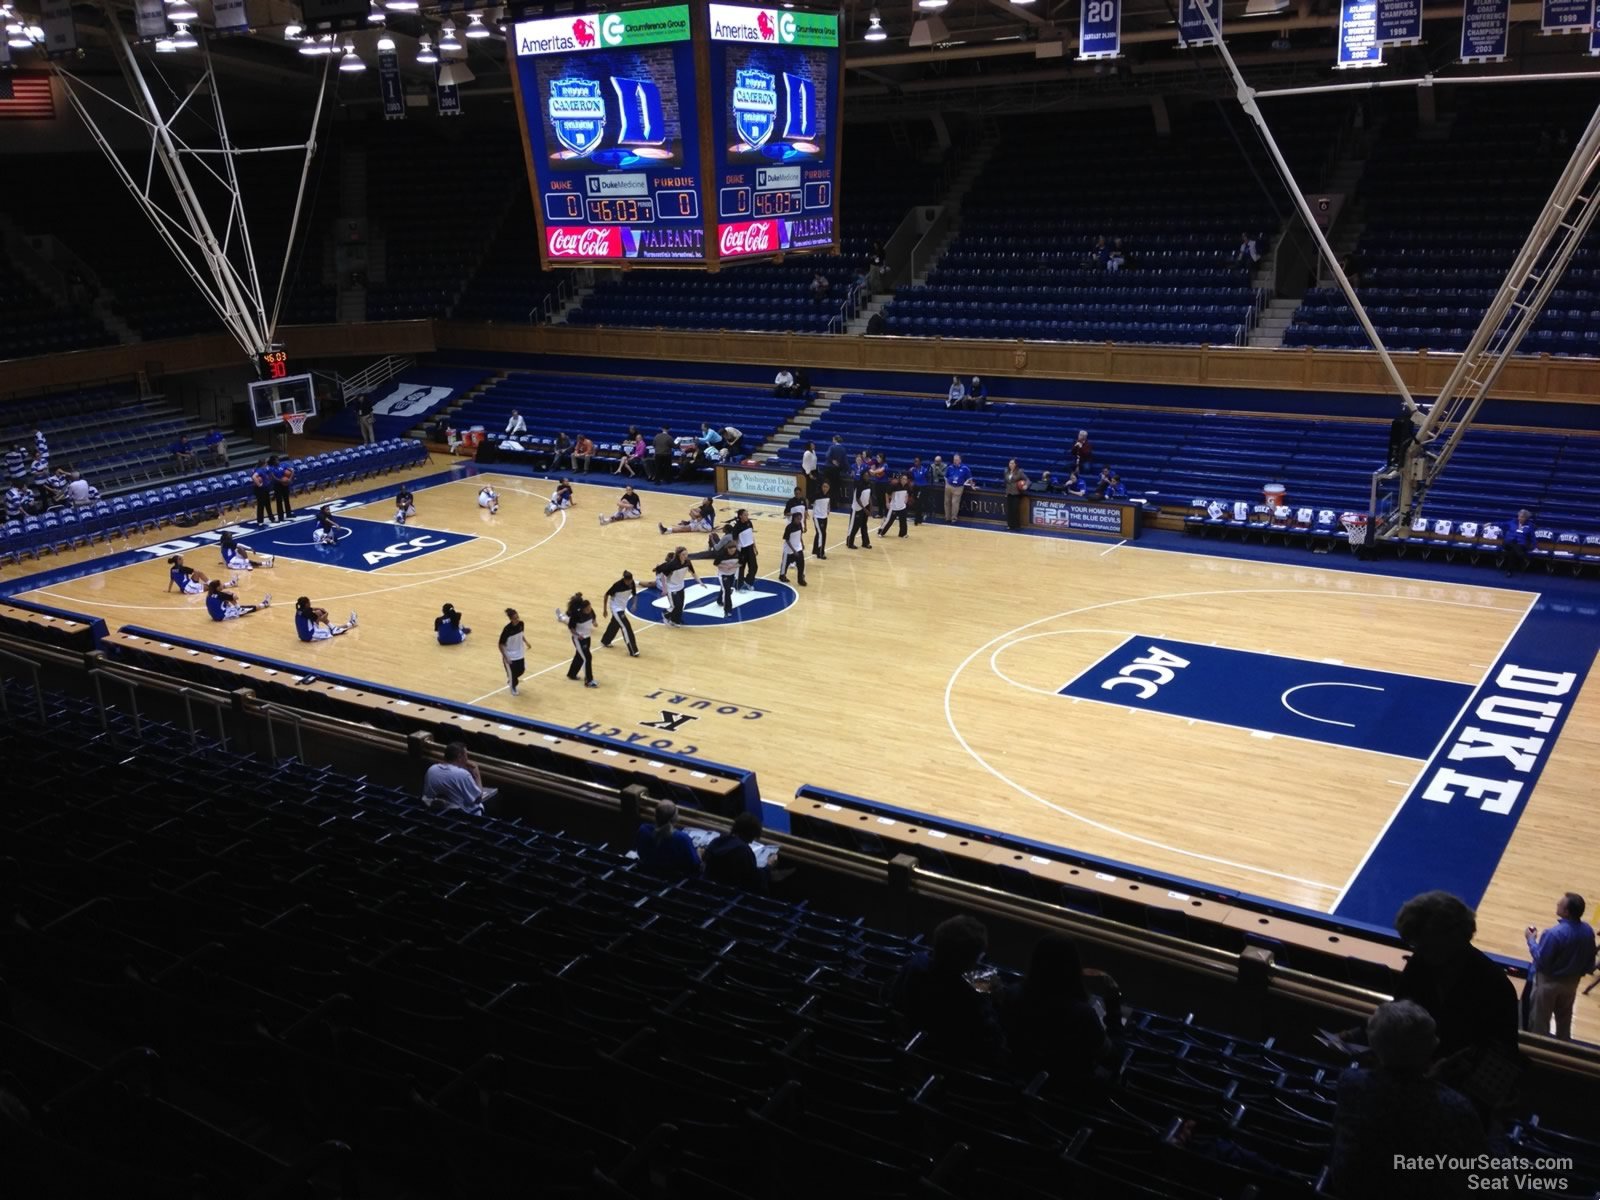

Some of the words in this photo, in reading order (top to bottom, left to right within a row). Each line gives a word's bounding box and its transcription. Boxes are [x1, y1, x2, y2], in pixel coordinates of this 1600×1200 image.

[1087, 1, 1114, 23] 20
[1380, 9, 1418, 19] CHAMPIONS
[1558, 14, 1578, 23] 1999
[667, 19, 687, 30] Group
[1390, 28, 1407, 36] 1998
[1475, 45, 1493, 54] 2003
[736, 90, 775, 106] CAMERON
[552, 100, 601, 112] CAMERON
[725, 174, 745, 185] DUKE
[804, 169, 831, 180] PURDUE
[550, 180, 573, 191] DUKE
[653, 176, 696, 188] PURDUE
[737, 190, 746, 212] 0
[818, 184, 827, 205] 0
[566, 195, 578, 217] 0
[678, 193, 691, 216] 0
[792, 216, 834, 238] VALEANT
[641, 229, 704, 248] VALEANT
[270, 361, 286, 379] 30
[742, 473, 778, 486] Washington
[1036, 500, 1050, 508] THE
[1050, 501, 1066, 509] NEW
[1192, 499, 1208, 508] DUKE
[1254, 505, 1270, 514] DUKE
[1033, 506, 1070, 521] 620
[1070, 505, 1088, 514] YOUR
[1088, 506, 1106, 515] HOME
[1107, 509, 1121, 517] FOR
[1070, 512, 1082, 520] THE
[1082, 514, 1099, 523] BLUE
[1099, 516, 1122, 525] DEVILS
[1534, 530, 1553, 539] DUKE
[1560, 534, 1579, 543] DUKE
[1586, 536, 1600, 545] DUK
[362, 535, 447, 565] ACC
[1101, 645, 1191, 700] ACC
[643, 690, 763, 720] COURT
[638, 710, 699, 732] K
[574, 721, 699, 755] COACH
[1421, 663, 1578, 816] DUKE
